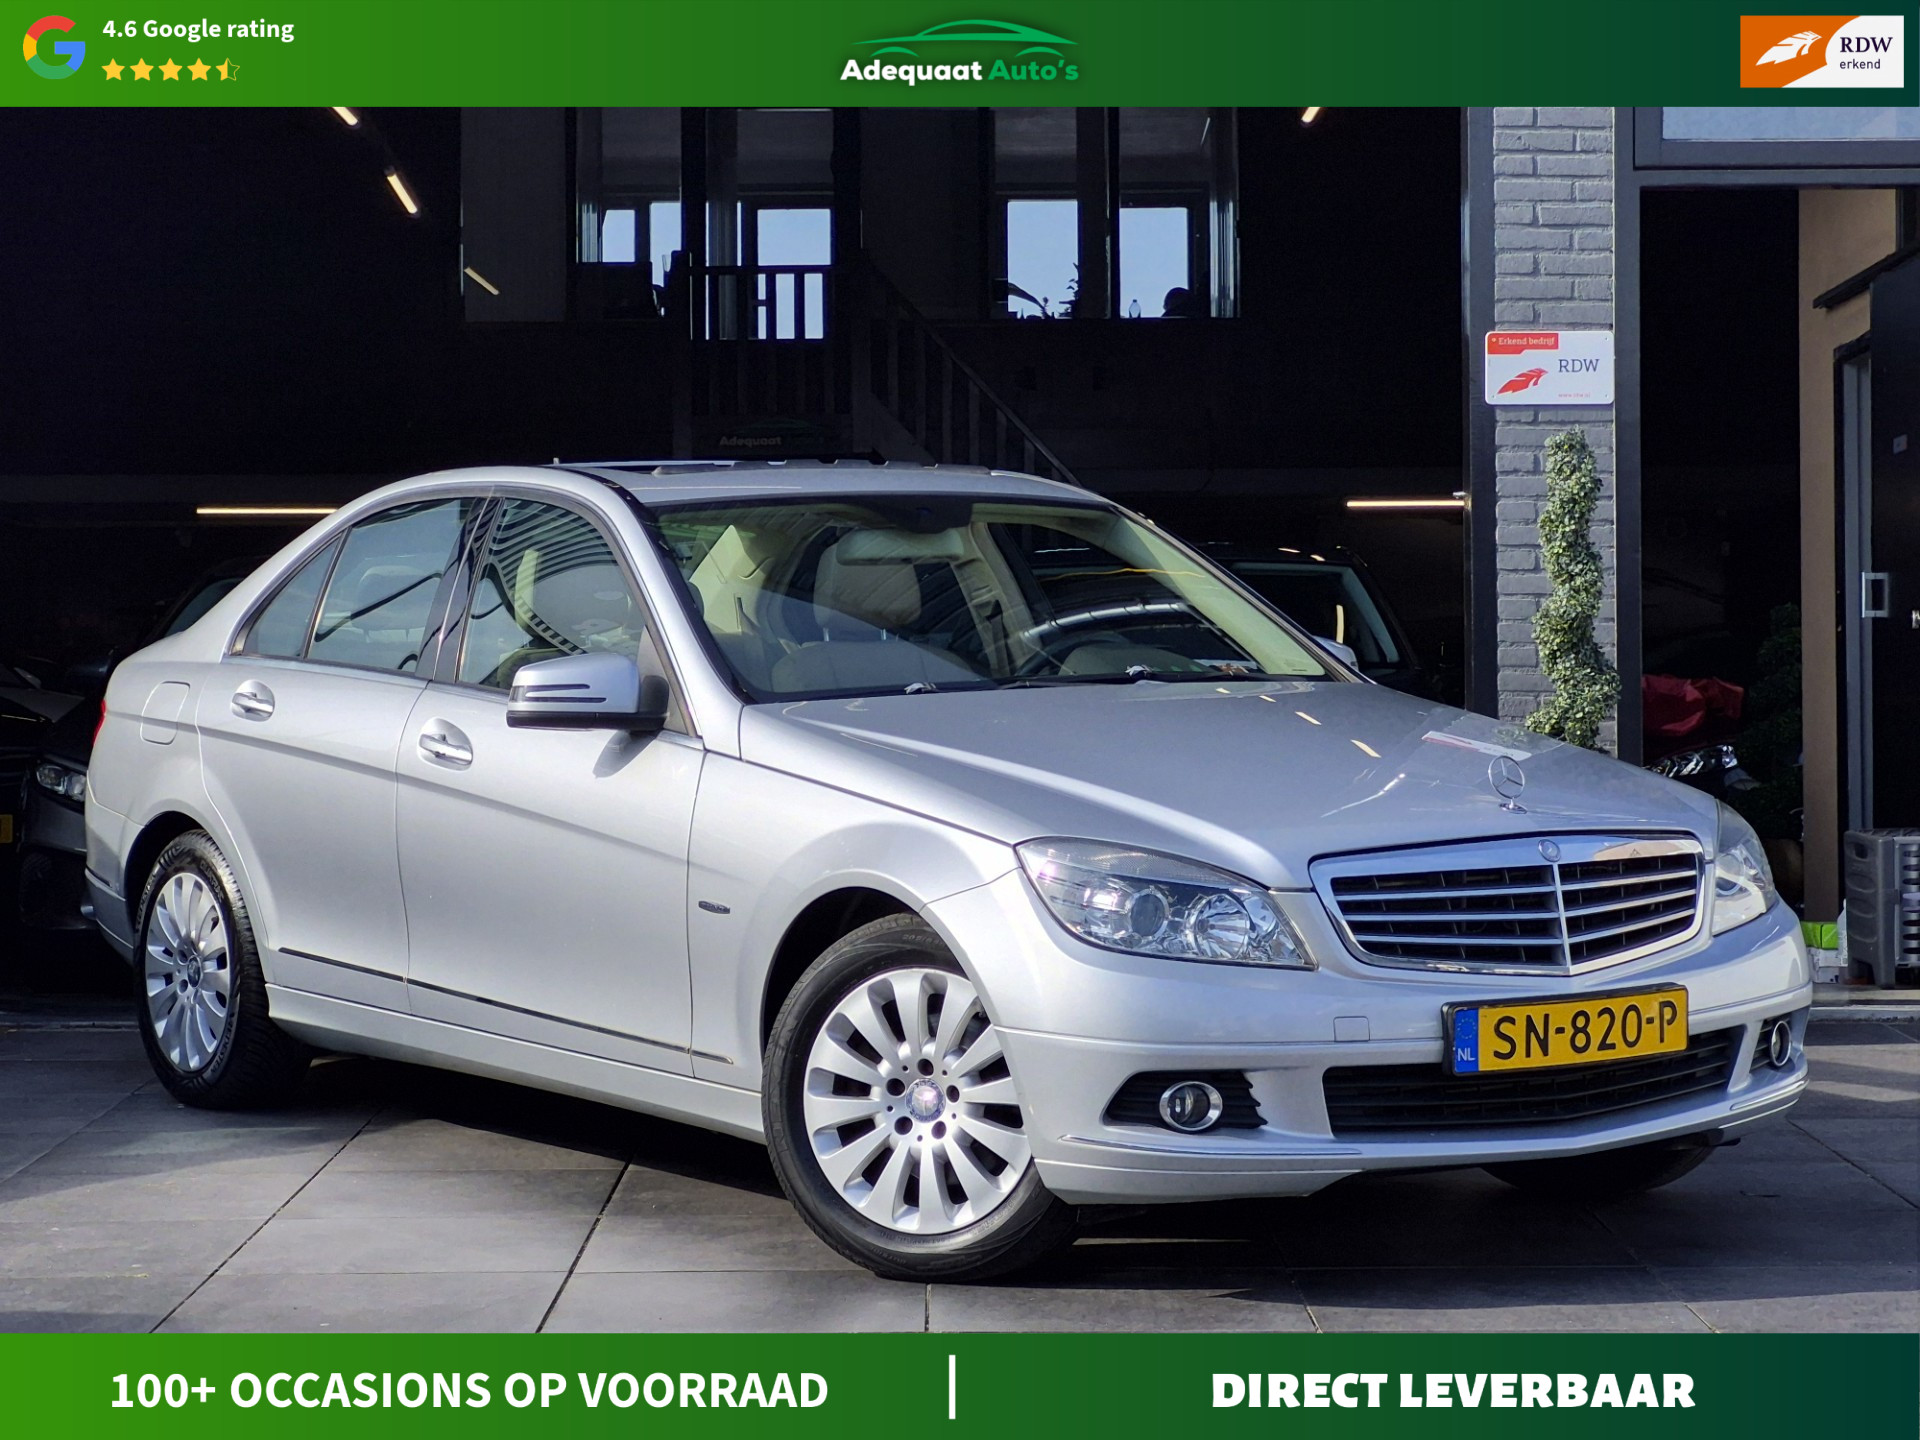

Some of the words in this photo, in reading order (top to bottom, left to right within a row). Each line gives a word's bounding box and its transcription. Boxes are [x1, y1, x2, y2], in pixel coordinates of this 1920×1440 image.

[1498, 337, 1527, 345] Erkend
[1528, 337, 1555, 346] bedrijf
[1558, 358, 1600, 373] RDW
[719, 436, 782, 447] Adequaat
[1493, 1000, 1678, 1060] SN-820-P
[1457, 1047, 1476, 1062] NL
